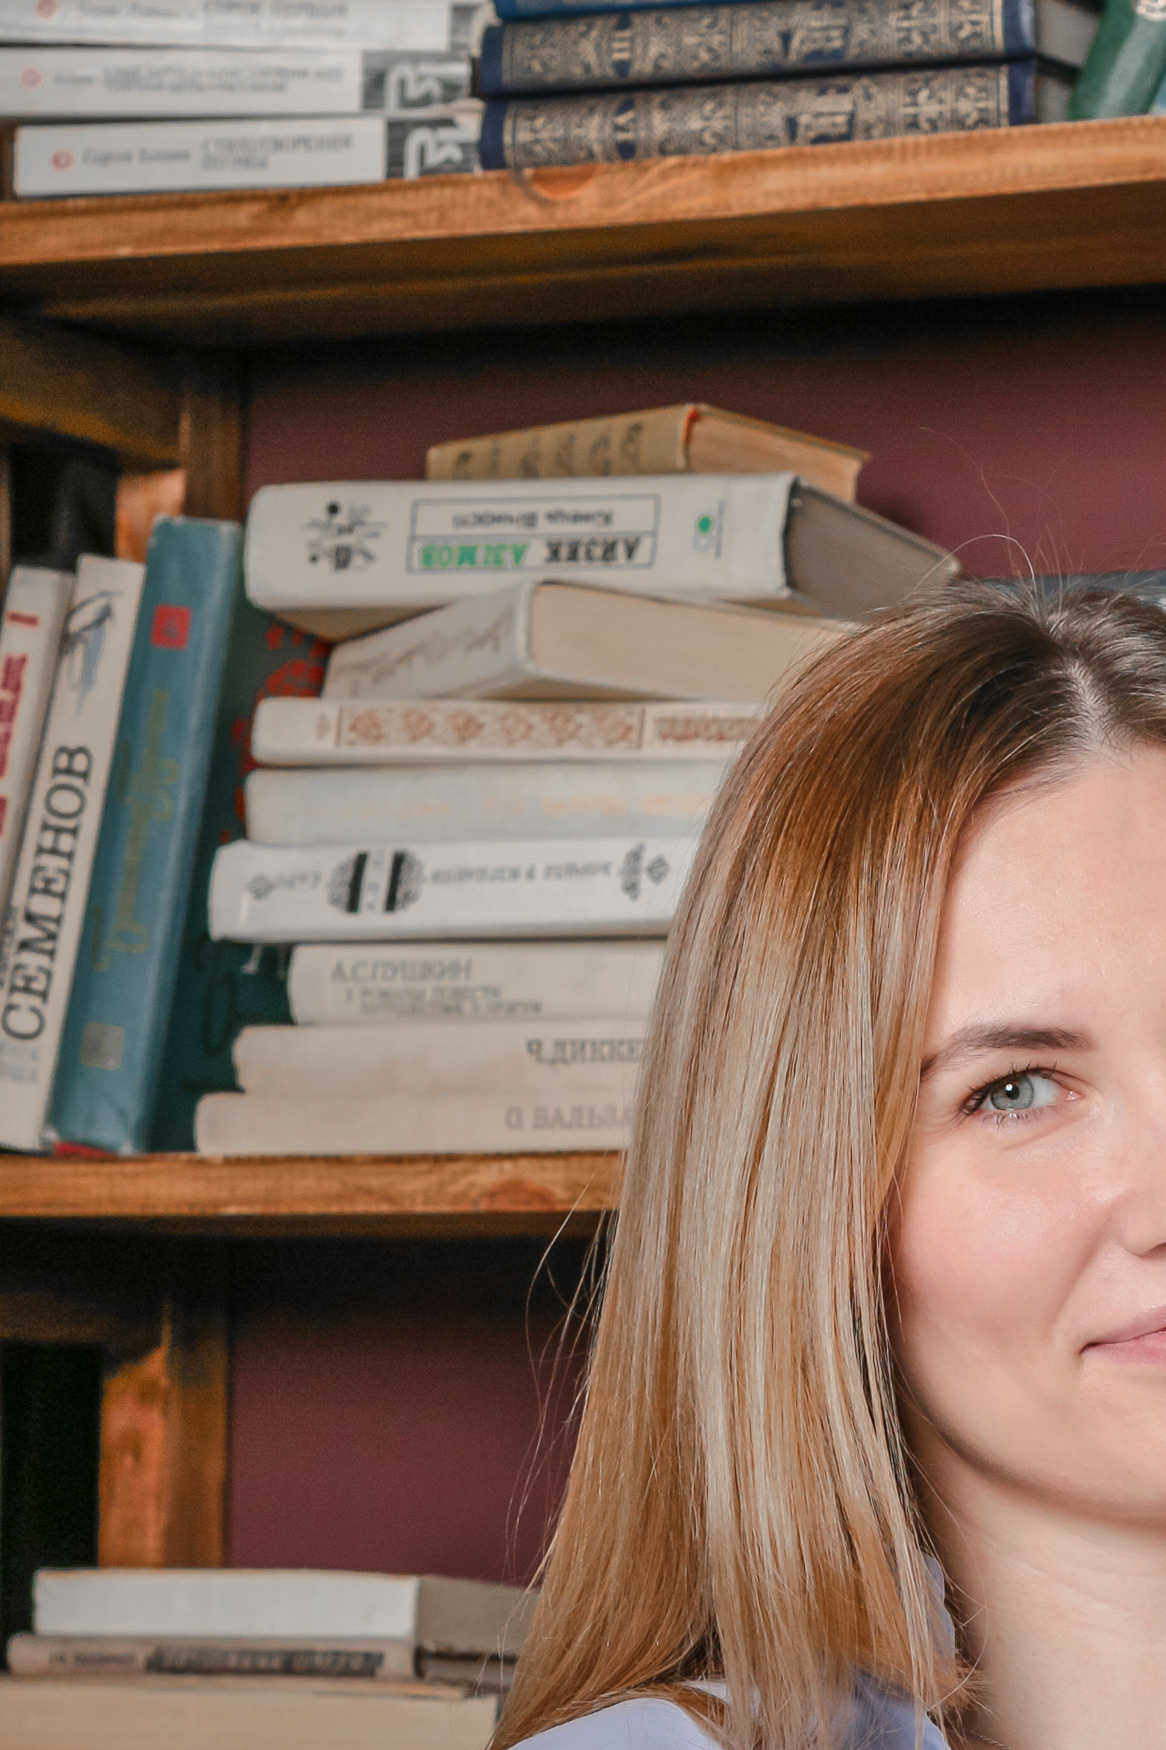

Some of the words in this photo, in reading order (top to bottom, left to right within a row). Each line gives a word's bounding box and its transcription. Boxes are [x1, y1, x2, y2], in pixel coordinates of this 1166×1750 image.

[452, 510, 538, 532] Вічності
[545, 509, 613, 530] Кінець
[420, 541, 529, 568] АЗІМОВ
[544, 536, 642, 566] АЙЗЕК
[1, 743, 95, 1043] СЕМЕНОВ
[526, 1037, 652, 1068] Ч.ДИККЕ
[533, 1104, 636, 1131] БАЛЬЗА
